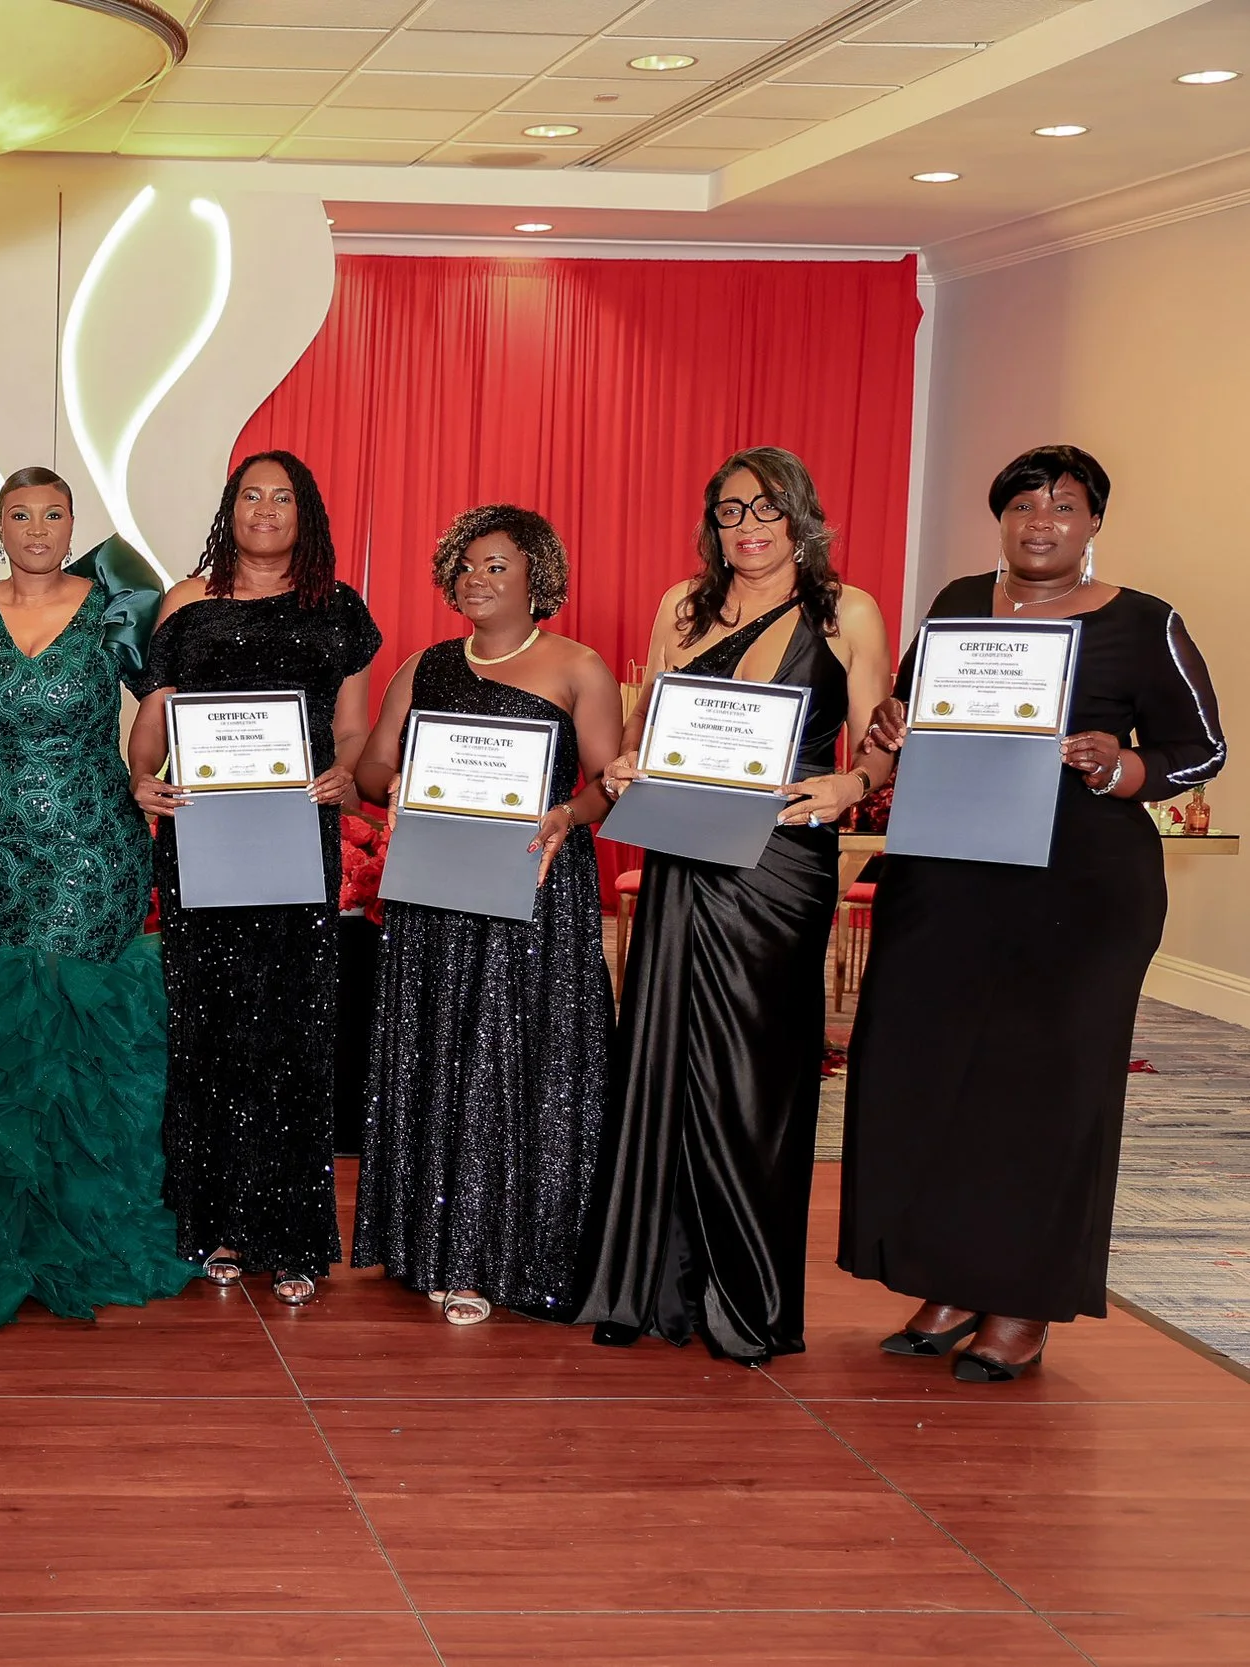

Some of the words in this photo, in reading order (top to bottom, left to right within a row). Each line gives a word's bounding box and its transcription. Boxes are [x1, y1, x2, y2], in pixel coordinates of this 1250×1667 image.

[959, 643, 1028, 652] CERTIFICATE
[958, 668, 999, 676] MYRLANDE
[695, 698, 761, 712] CERTIFICATE
[208, 712, 268, 720] CERTIFICATE
[690, 722, 723, 732] MARJORIE
[725, 725, 754, 735] DUPLAN
[450, 734, 513, 747] CERTIFICATE
[451, 757, 482, 766] VANESSA
[483, 760, 507, 768] SANON
